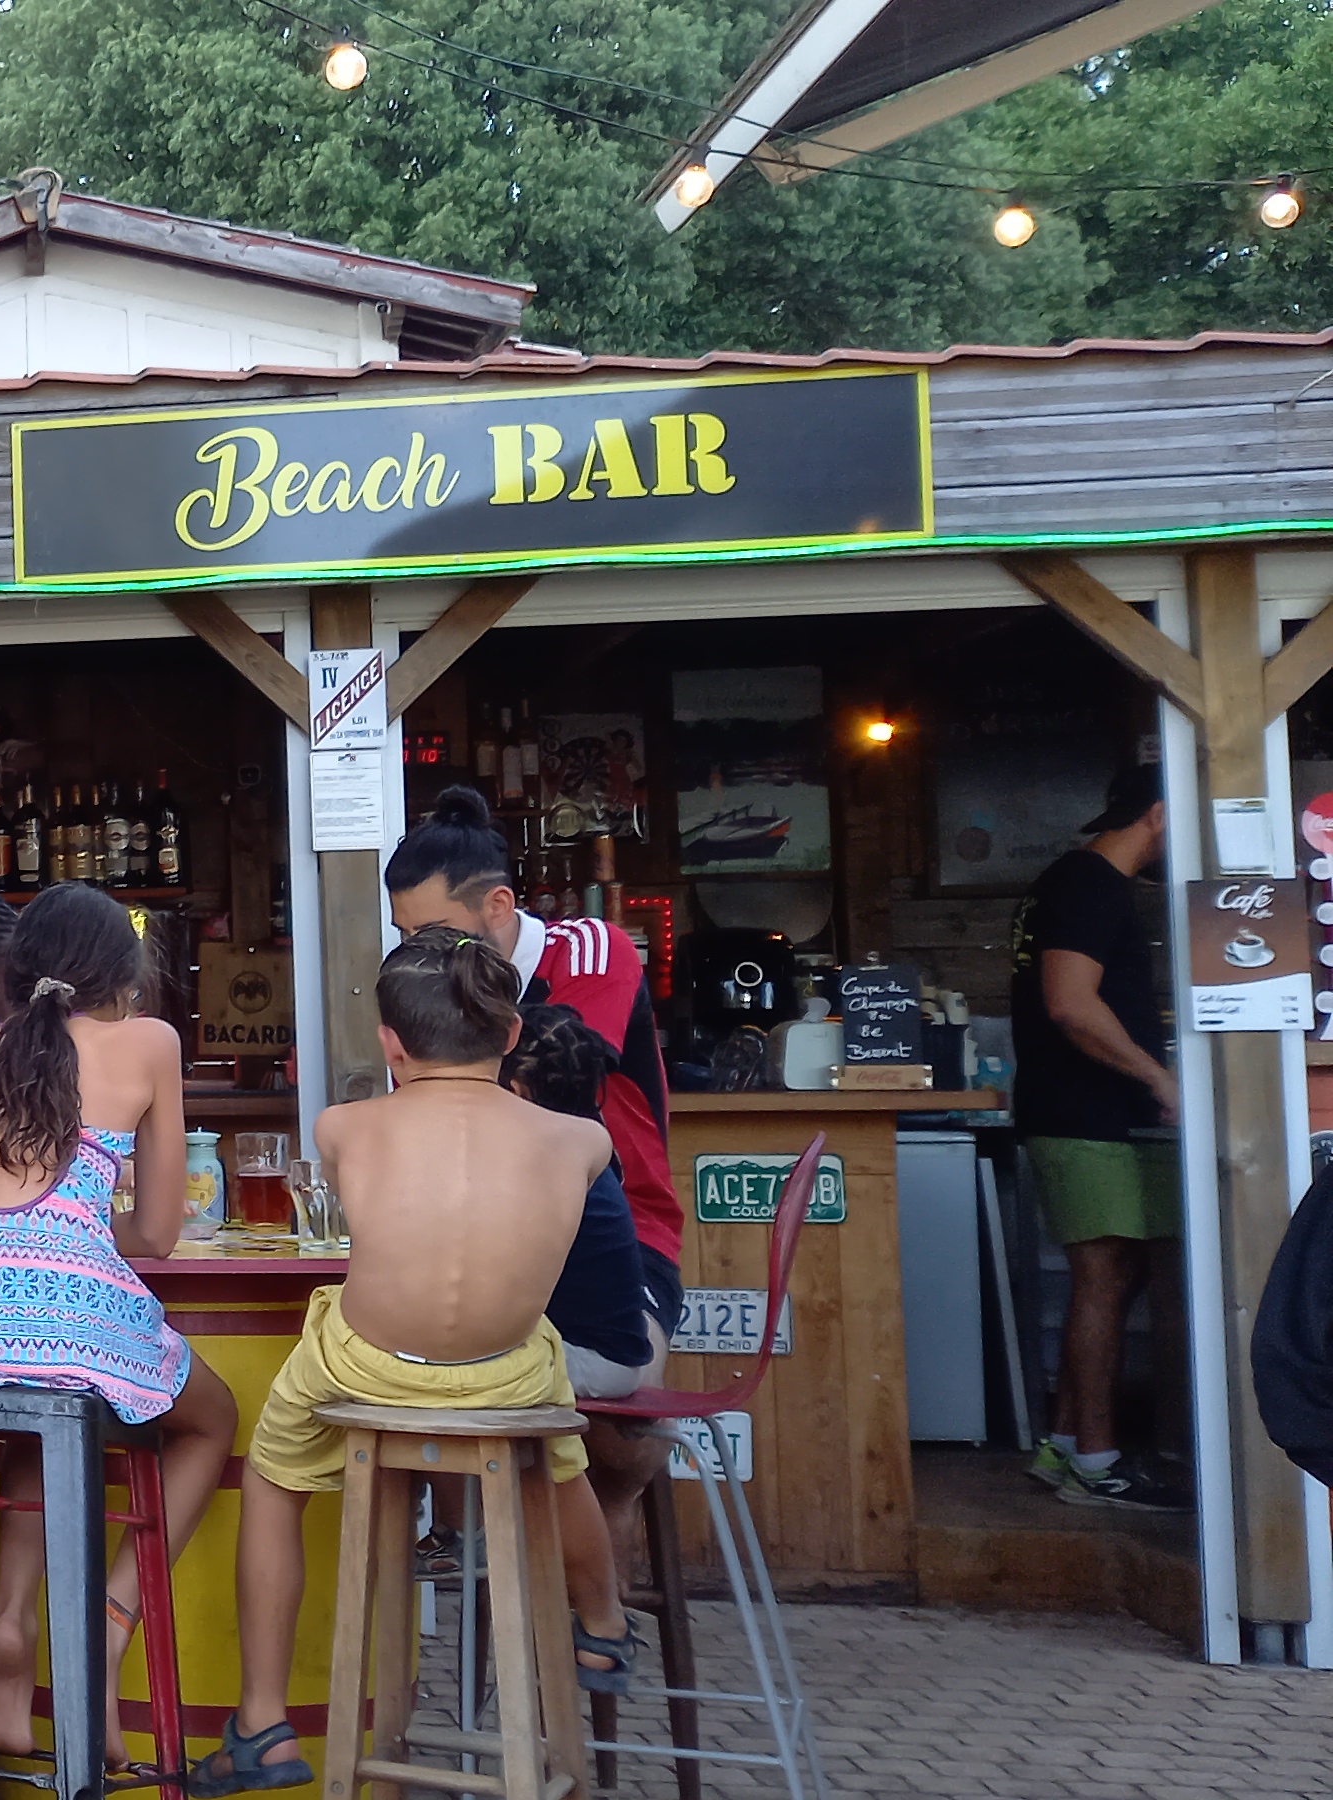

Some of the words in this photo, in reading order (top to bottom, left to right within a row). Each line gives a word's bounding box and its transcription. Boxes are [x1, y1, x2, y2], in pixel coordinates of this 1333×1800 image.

[174, 426, 459, 552] Beach
[487, 412, 736, 505] BAR
[321, 667, 339, 689] IV
[315, 658, 380, 739] LICENCE
[1216, 884, 1276, 915] Café
[204, 1024, 292, 1045] BACARD
[705, 1173, 837, 1205] ACE78
[730, 1206, 812, 1217] COLOO
[675, 1303, 782, 1338] 212E
[717, 1339, 752, 1351] OHIO
